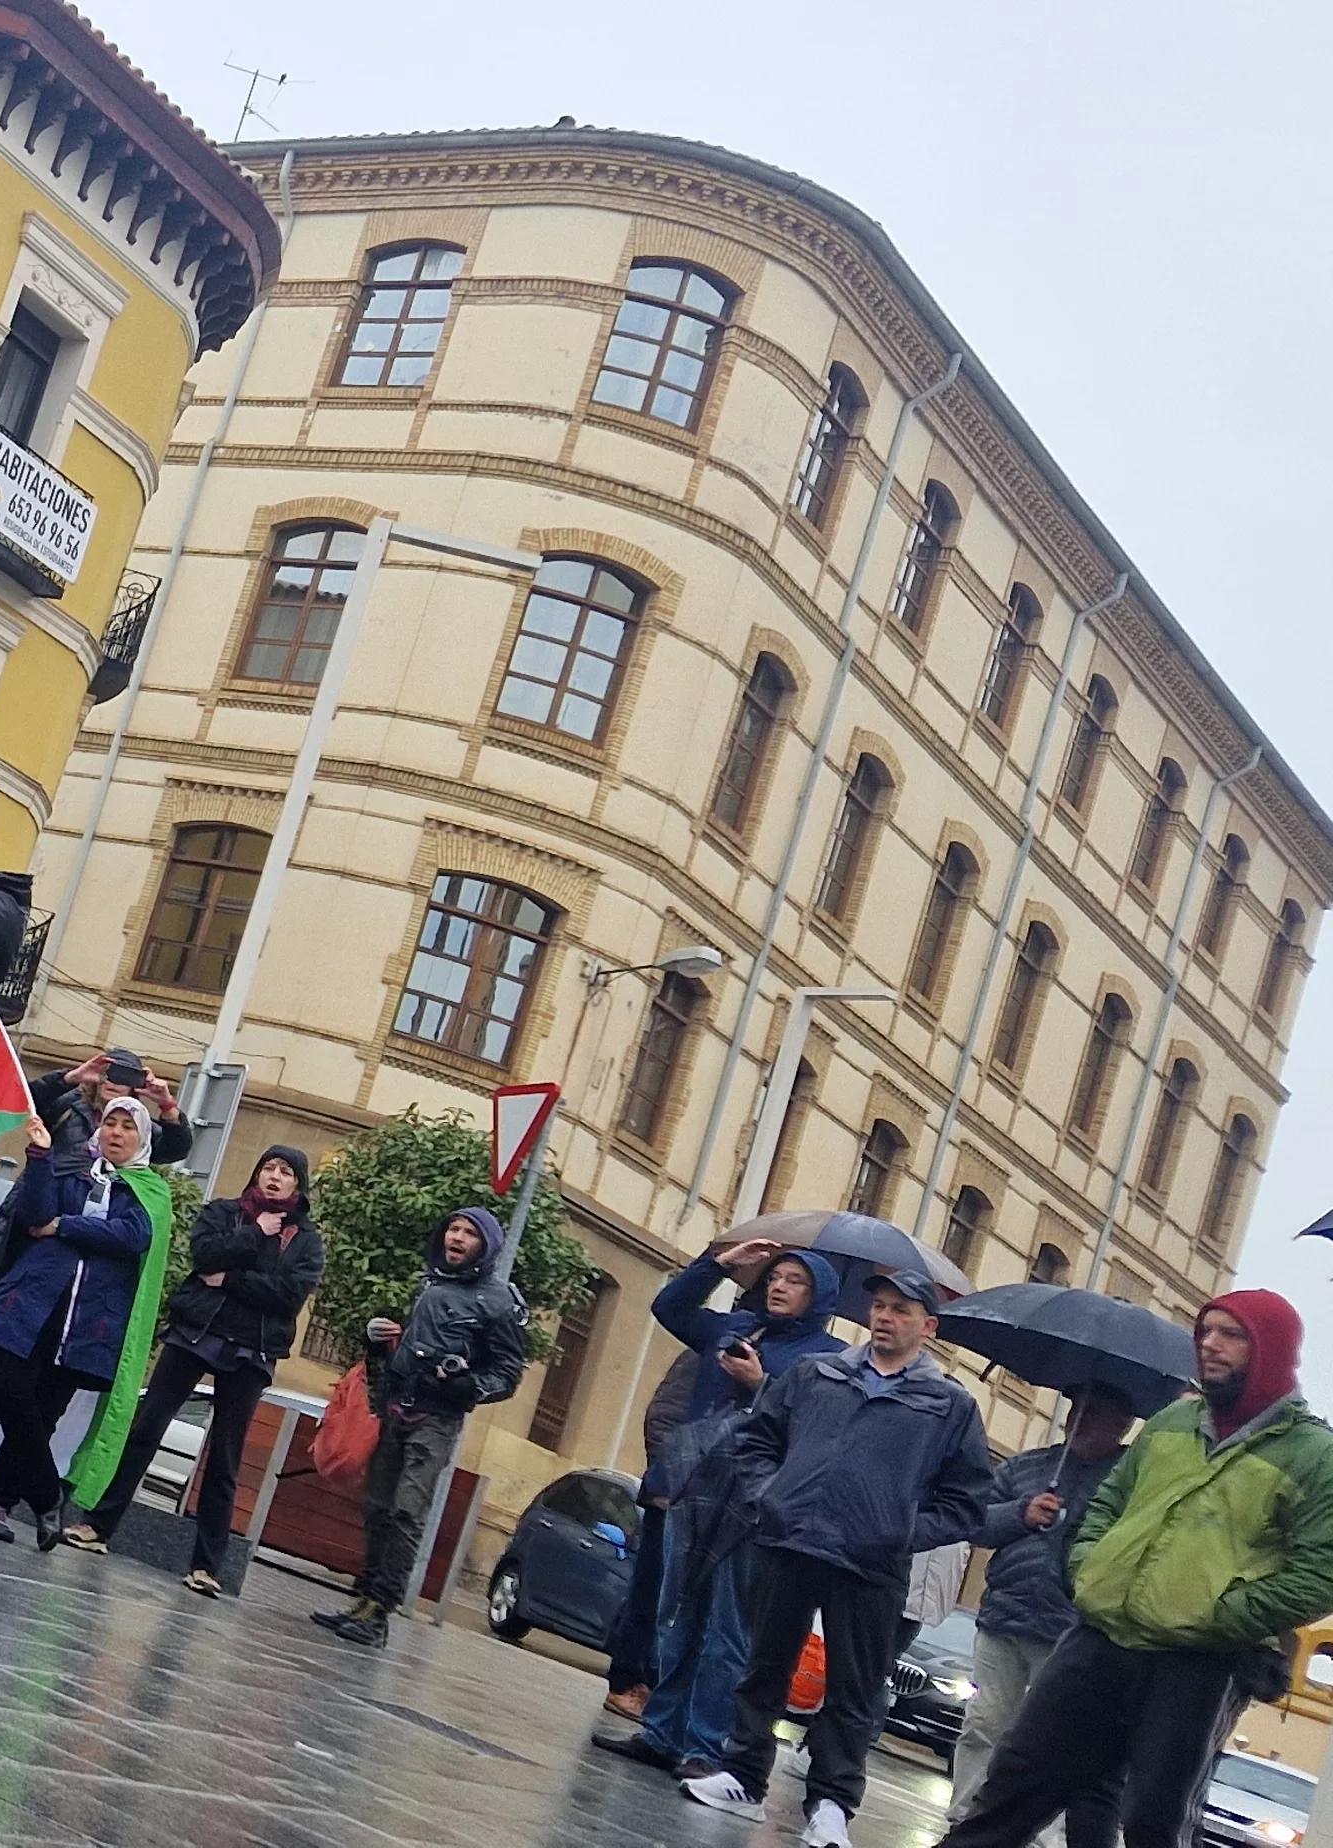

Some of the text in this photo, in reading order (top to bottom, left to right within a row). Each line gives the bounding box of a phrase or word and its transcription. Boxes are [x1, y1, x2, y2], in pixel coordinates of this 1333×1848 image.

[8, 493, 32, 524] 653
[32, 510, 48, 536] 96
[48, 522, 64, 548] 96
[64, 534, 80, 561] 56
